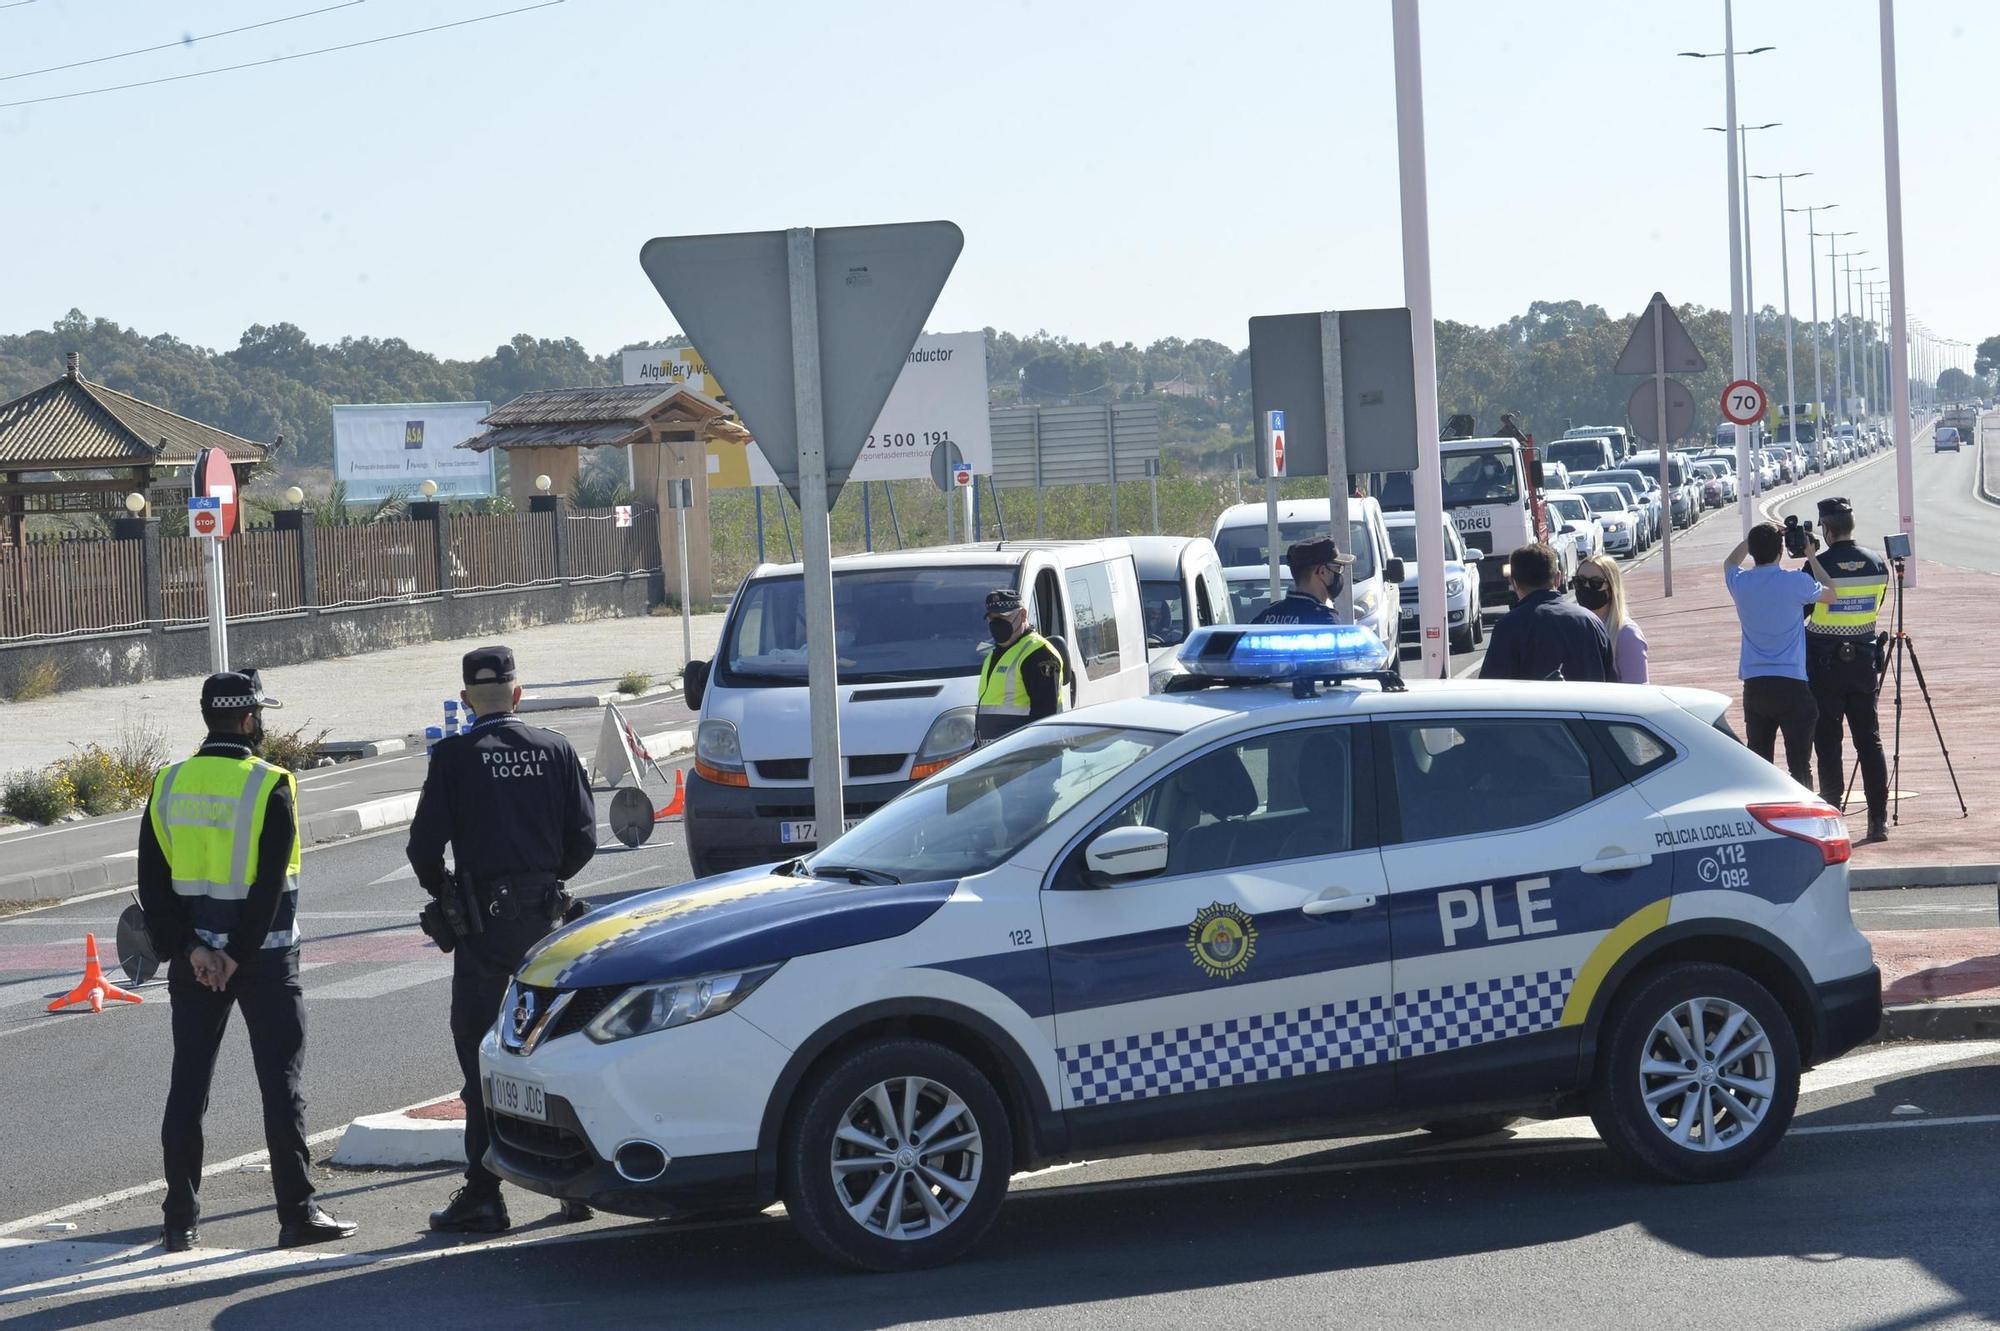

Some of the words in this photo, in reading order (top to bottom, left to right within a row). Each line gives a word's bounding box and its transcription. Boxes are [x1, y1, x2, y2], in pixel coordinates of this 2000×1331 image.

[640, 362, 684, 381] Alquiler
[687, 364, 693, 379] y
[1733, 396, 1755, 410] 70
[406, 427, 422, 443] ASA
[883, 433, 915, 448] 500
[923, 431, 949, 446] 191
[196, 519, 215, 527] STOP
[481, 749, 549, 764] POLICIA
[492, 763, 544, 778] LOCAL
[796, 824, 817, 840] 17
[1655, 828, 1701, 847] POLICIA
[1699, 823, 1736, 841] LOCAL
[1735, 821, 1757, 836] ELX
[1716, 844, 1747, 865] 112
[1721, 868, 1750, 889] 092
[1437, 877, 1558, 947] PLE
[1009, 929, 1033, 946] 122
[496, 1078, 519, 1109] 0199
[524, 1085, 543, 1114] JDG
